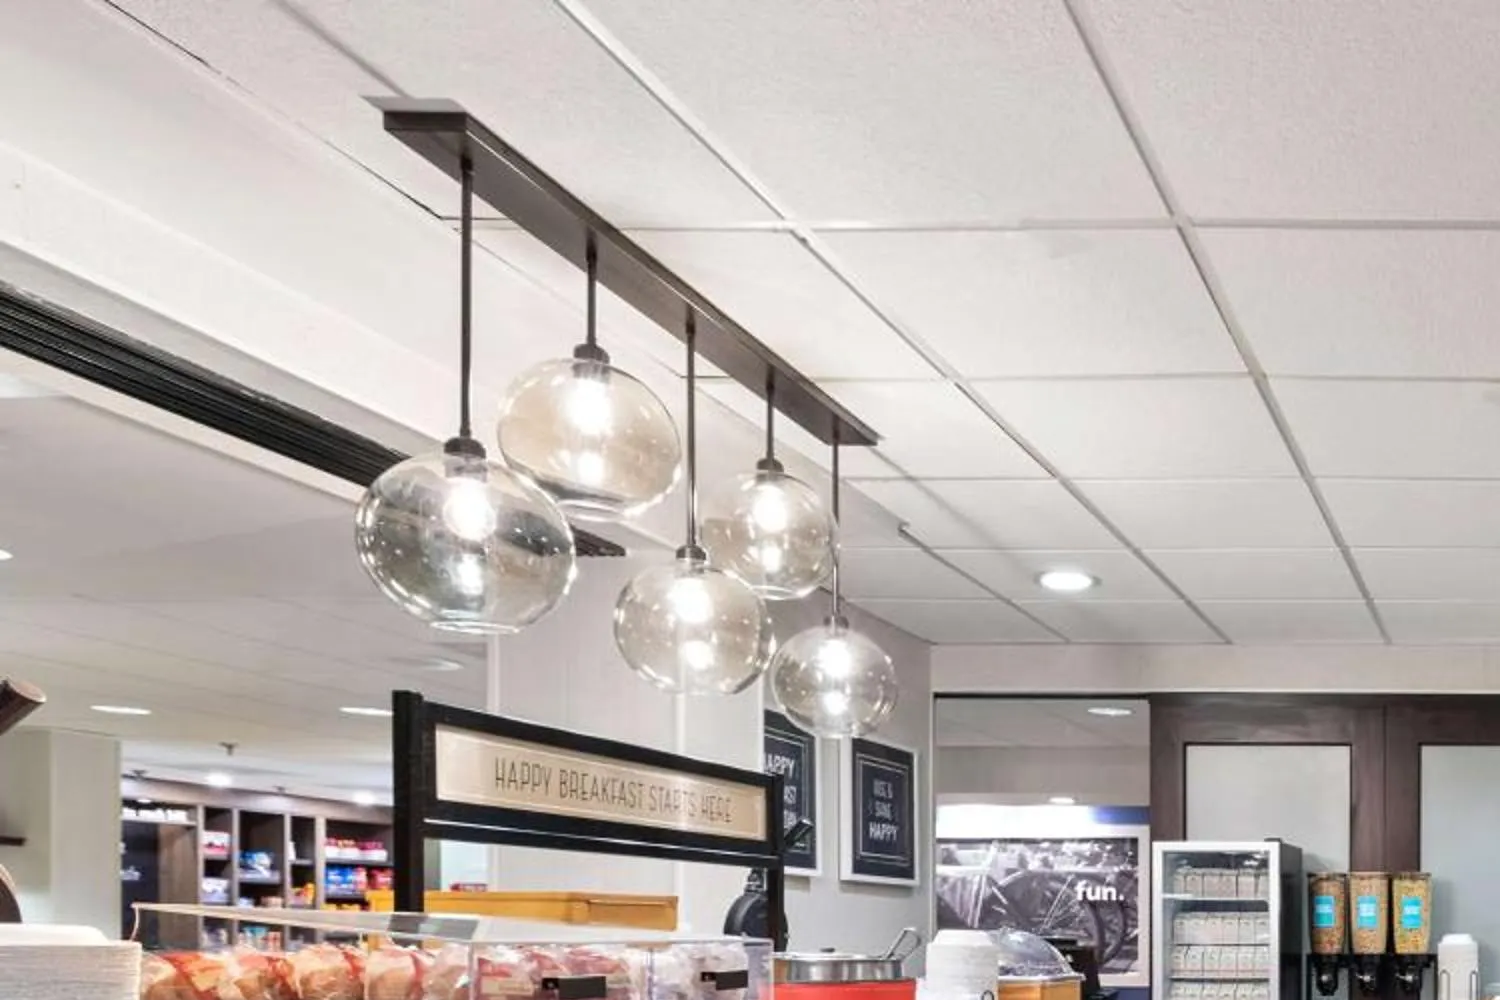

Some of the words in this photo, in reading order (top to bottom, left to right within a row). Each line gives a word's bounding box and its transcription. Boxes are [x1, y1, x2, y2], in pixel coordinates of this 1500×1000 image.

[495, 757, 552, 796] HAPPY
[560, 769, 643, 809] BREAKFAST
[650, 786, 695, 817] STARTS
[701, 795, 733, 823] HERE
[1074, 880, 1124, 900] fun.
